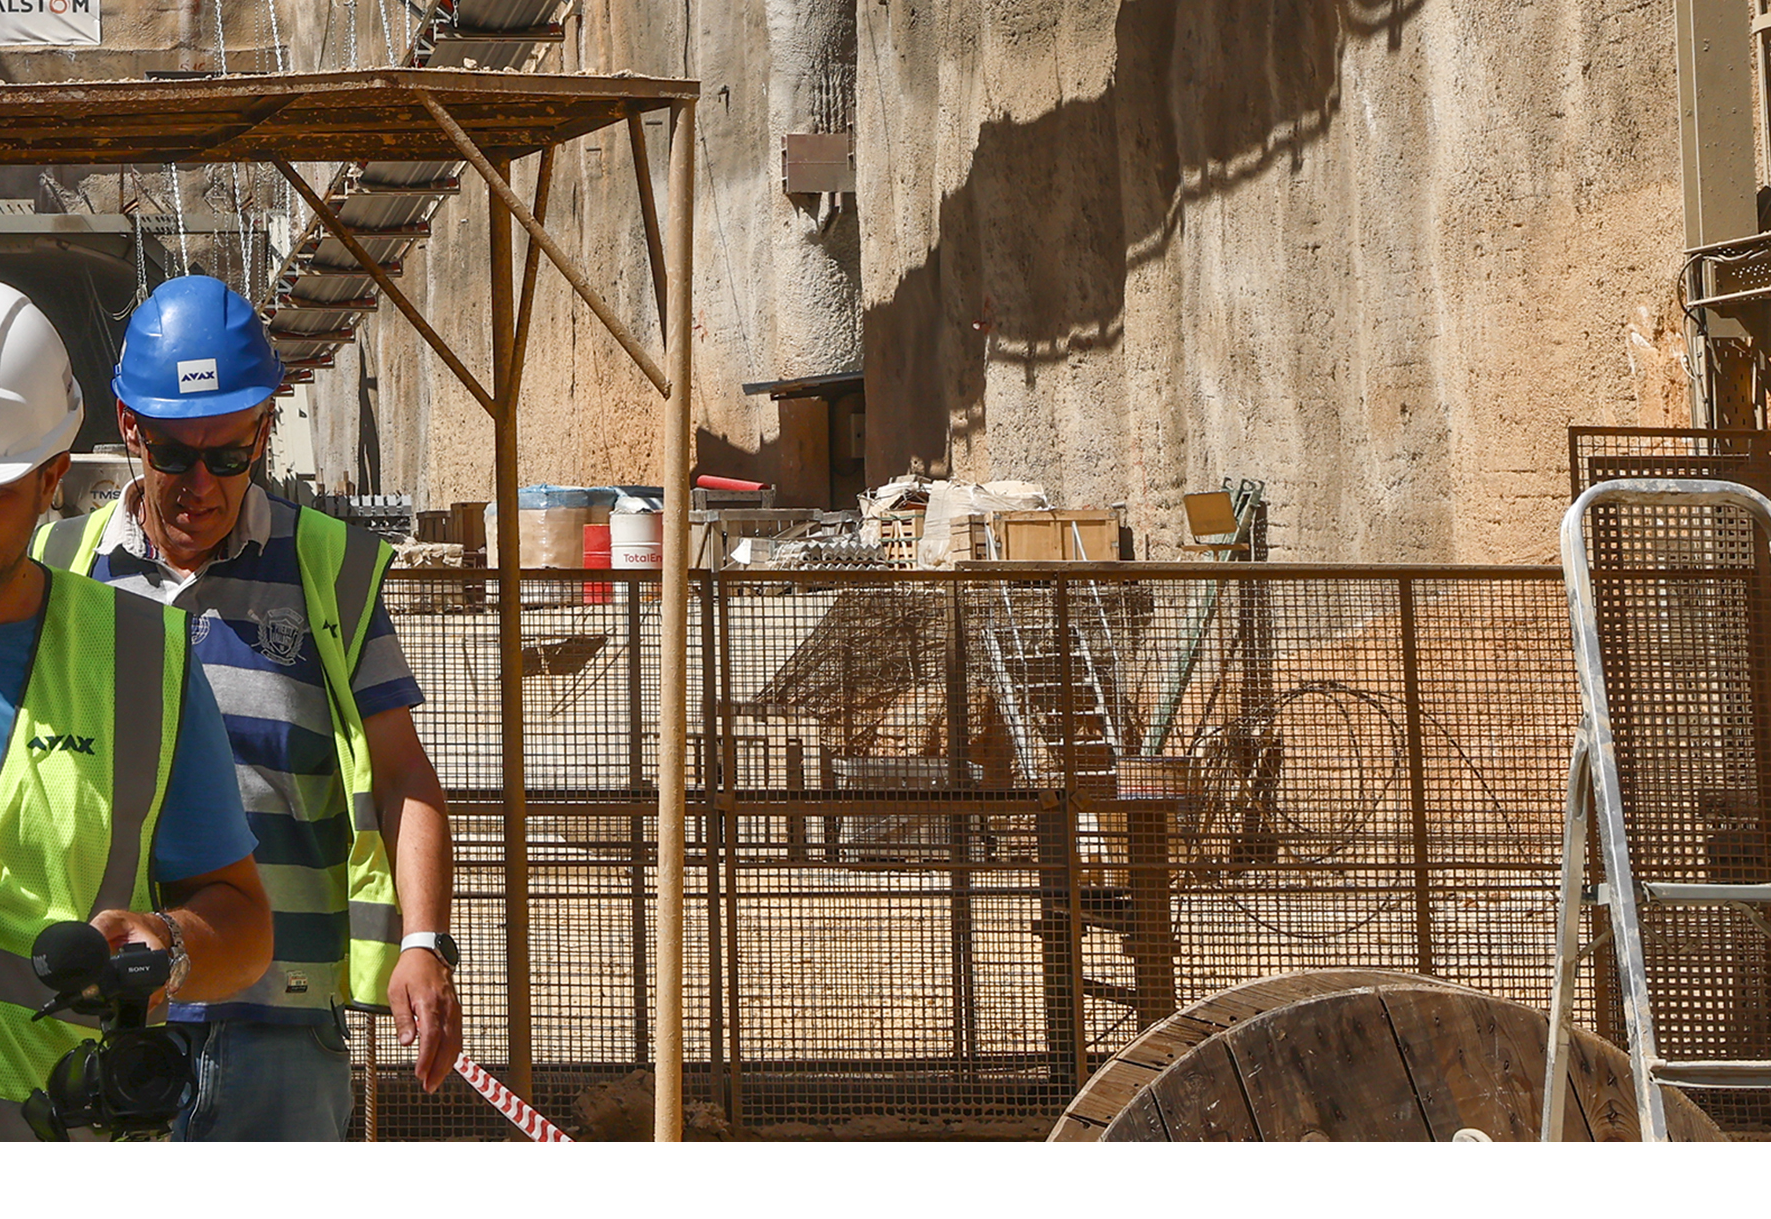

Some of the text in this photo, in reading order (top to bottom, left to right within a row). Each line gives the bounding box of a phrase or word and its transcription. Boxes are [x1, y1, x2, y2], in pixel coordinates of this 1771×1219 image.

[181, 371, 215, 382] AVAX
[90, 490, 121, 499] TMS
[27, 734, 95, 755] AVAX
[128, 965, 150, 973] SONY
